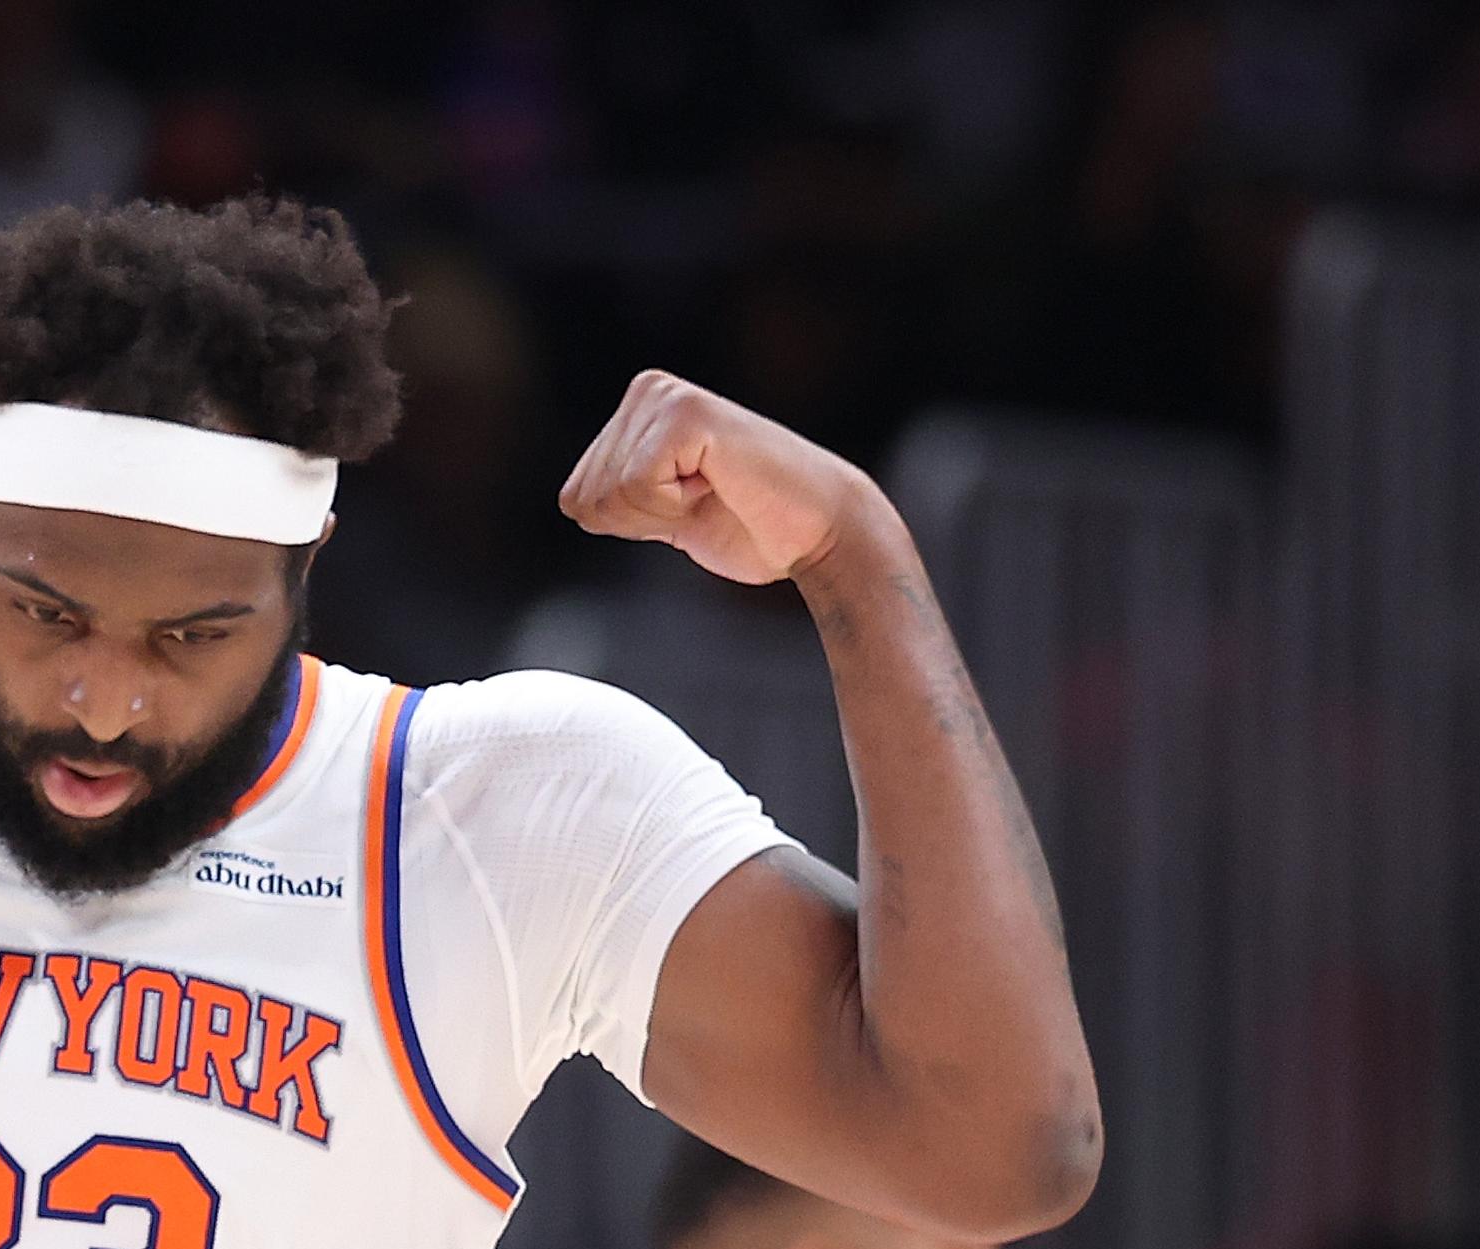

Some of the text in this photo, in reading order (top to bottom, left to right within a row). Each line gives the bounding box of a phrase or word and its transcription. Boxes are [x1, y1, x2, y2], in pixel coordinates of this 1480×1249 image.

[199, 851, 276, 870] experience
[195, 863, 344, 899] abu dhabi
[42, 950, 346, 1149] YORK
